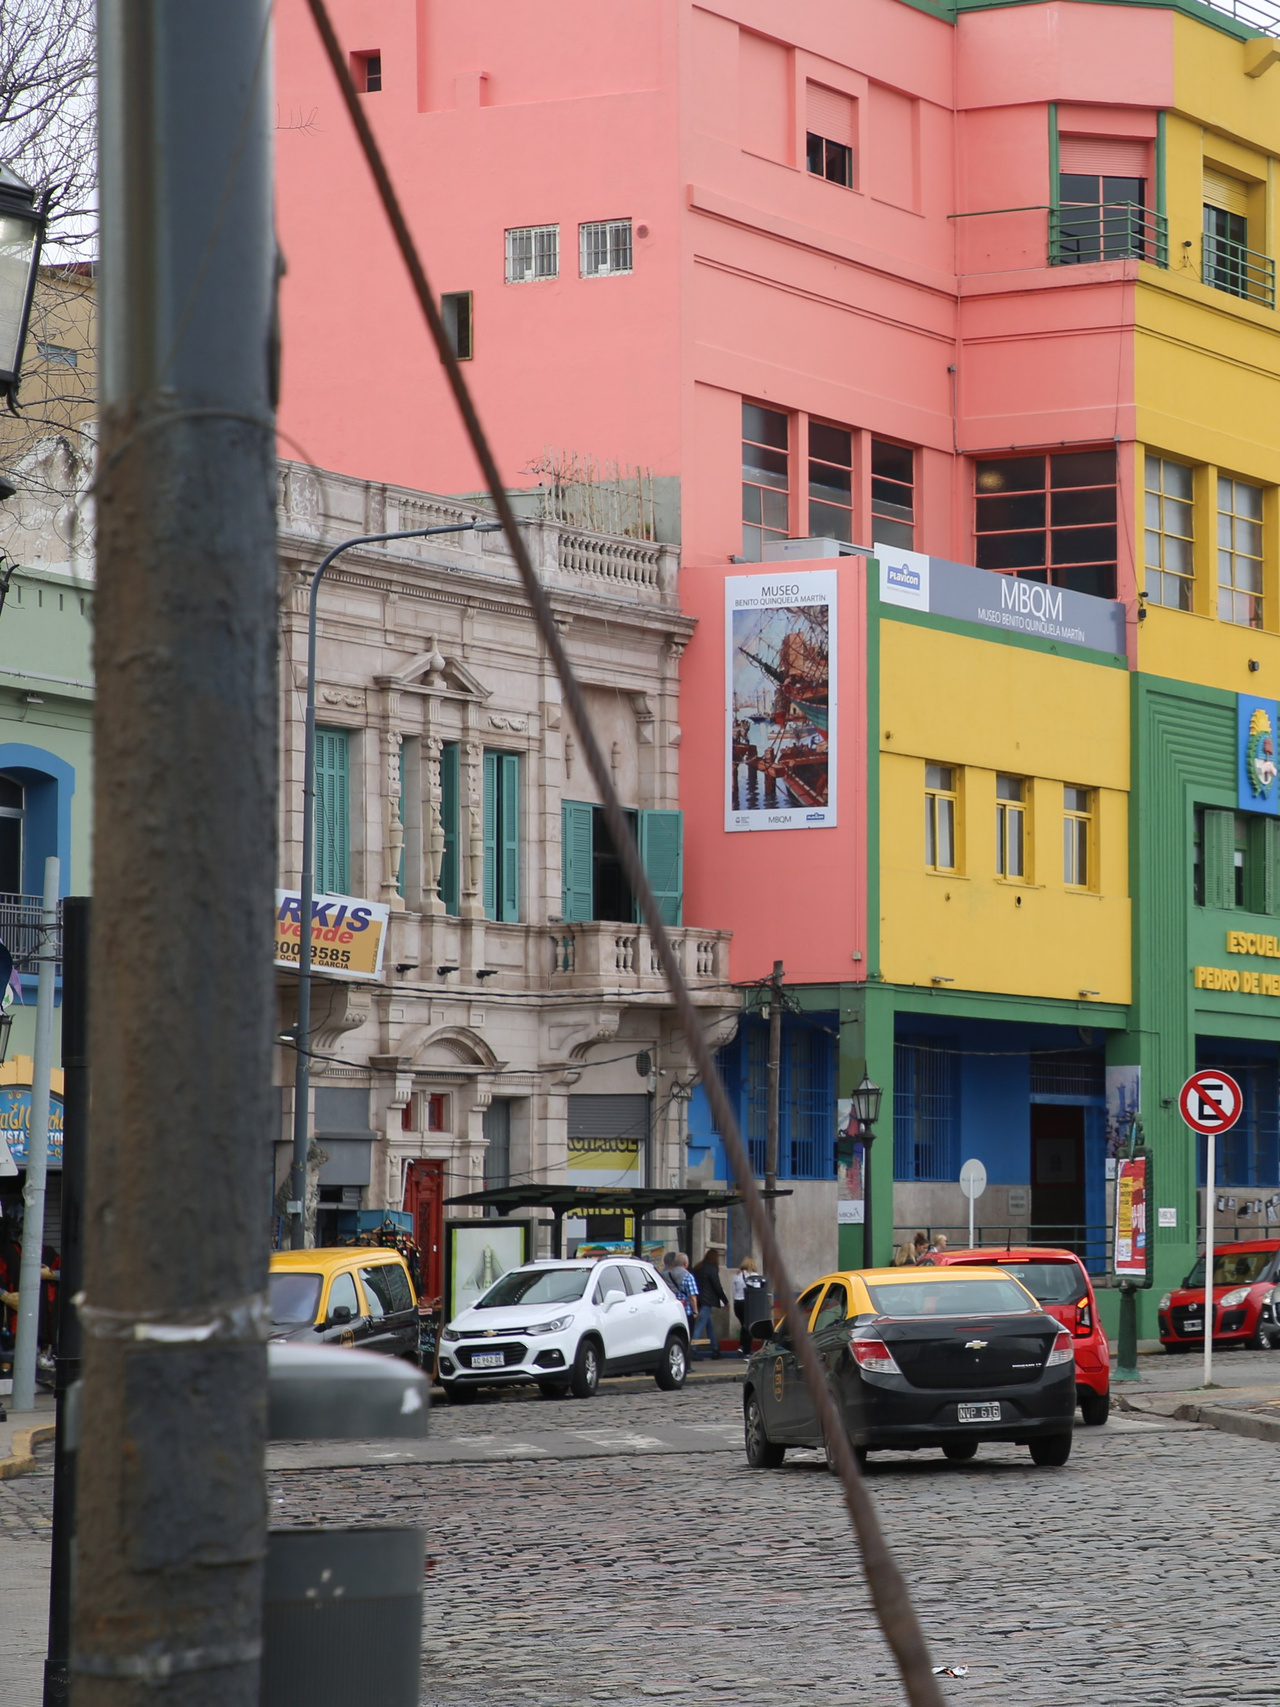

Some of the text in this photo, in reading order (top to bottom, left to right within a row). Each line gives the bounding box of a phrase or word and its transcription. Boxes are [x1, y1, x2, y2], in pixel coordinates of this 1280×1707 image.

[735, 593, 826, 607] BENITO QUINQUELA MARTÍN
[761, 584, 800, 597] MUSEO
[1001, 577, 1064, 622] MBQM
[977, 607, 1085, 643] MUSEO BENITO QUINQUELA MARTÍN
[768, 815, 792, 824] MBQM
[1194, 966, 1241, 993] PEDRO
[1241, 970, 1261, 995] DE
[1198, 1083, 1225, 1121] E
[960, 1406, 999, 1419] NVP 616
